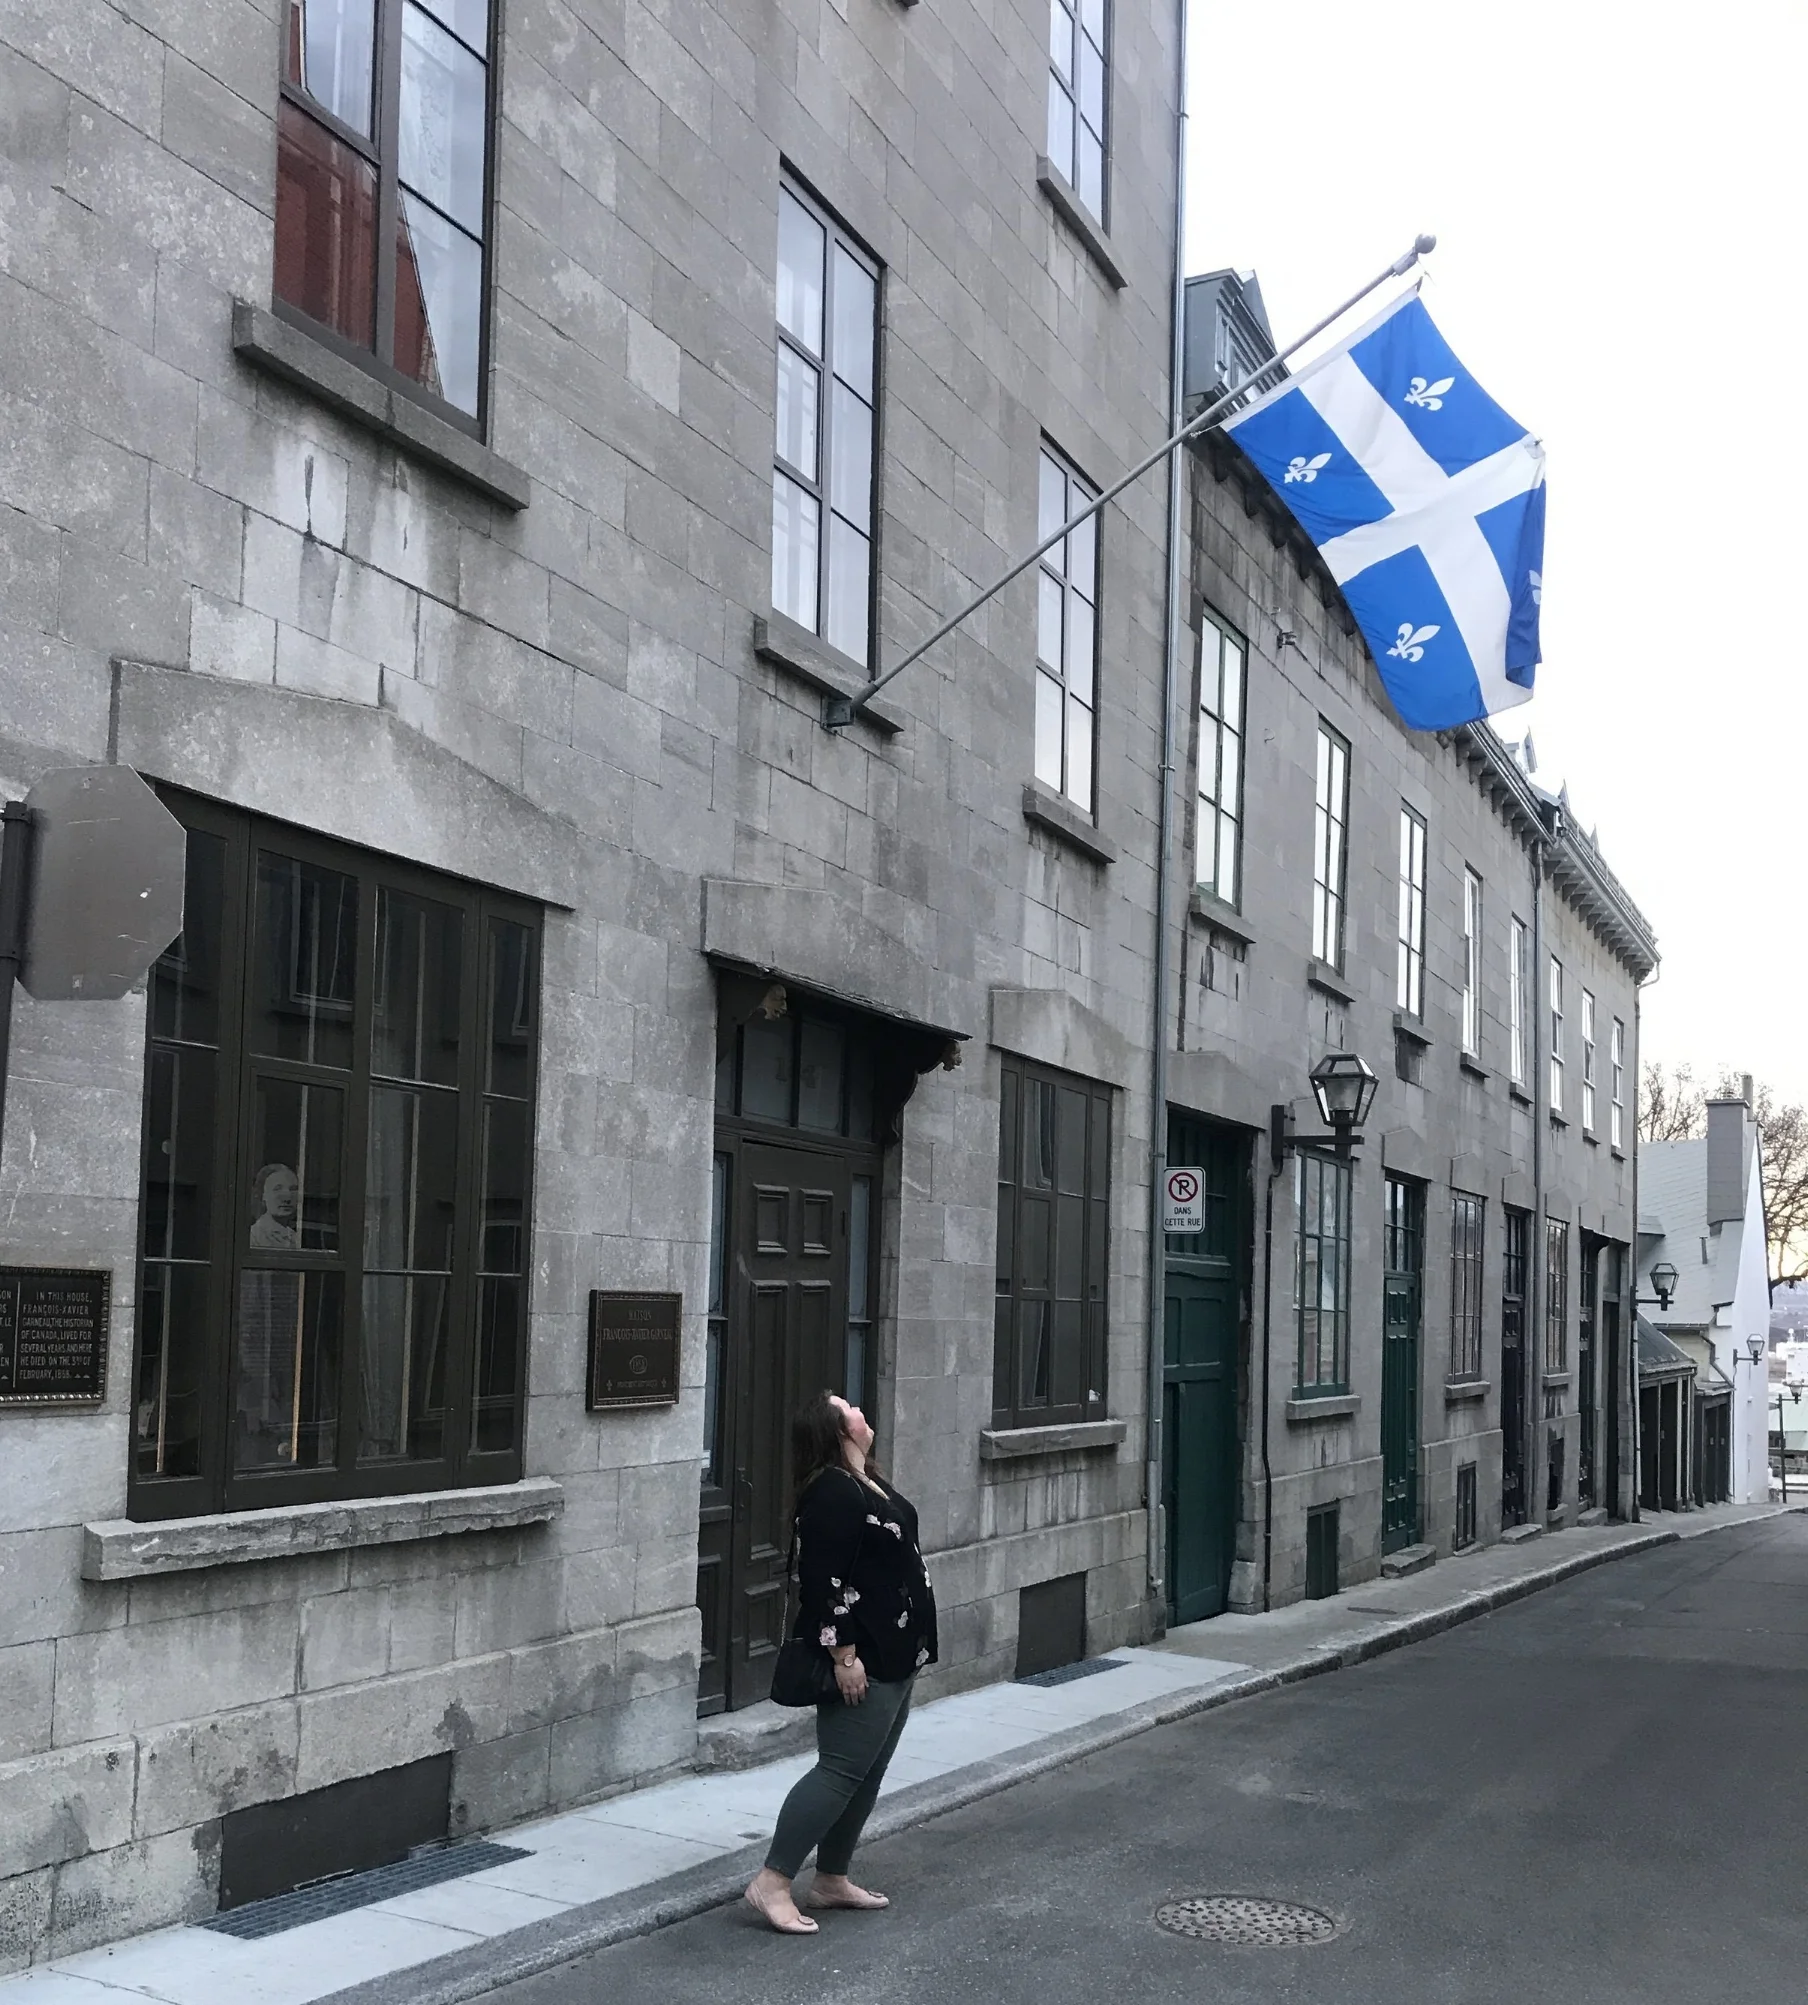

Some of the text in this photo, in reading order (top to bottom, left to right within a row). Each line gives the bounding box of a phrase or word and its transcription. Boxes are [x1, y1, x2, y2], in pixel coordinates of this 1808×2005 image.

[1173, 1206, 1192, 1215] DANS
[1164, 1217, 1201, 1226] CETTE RUE
[36, 1291, 45, 1301] IN
[48, 1291, 65, 1301] THIS
[20, 1330, 30, 1340] OF
[60, 1331, 78, 1340] LIVED
[79, 1331, 92, 1340] FOR
[20, 1343, 47, 1353] SEVERAL
[20, 1356, 30, 1366] HE
[30, 1356, 46, 1366] DIED
[48, 1356, 58, 1366] ON
[58, 1356, 71, 1366] THE
[83, 1356, 92, 1366] OF
